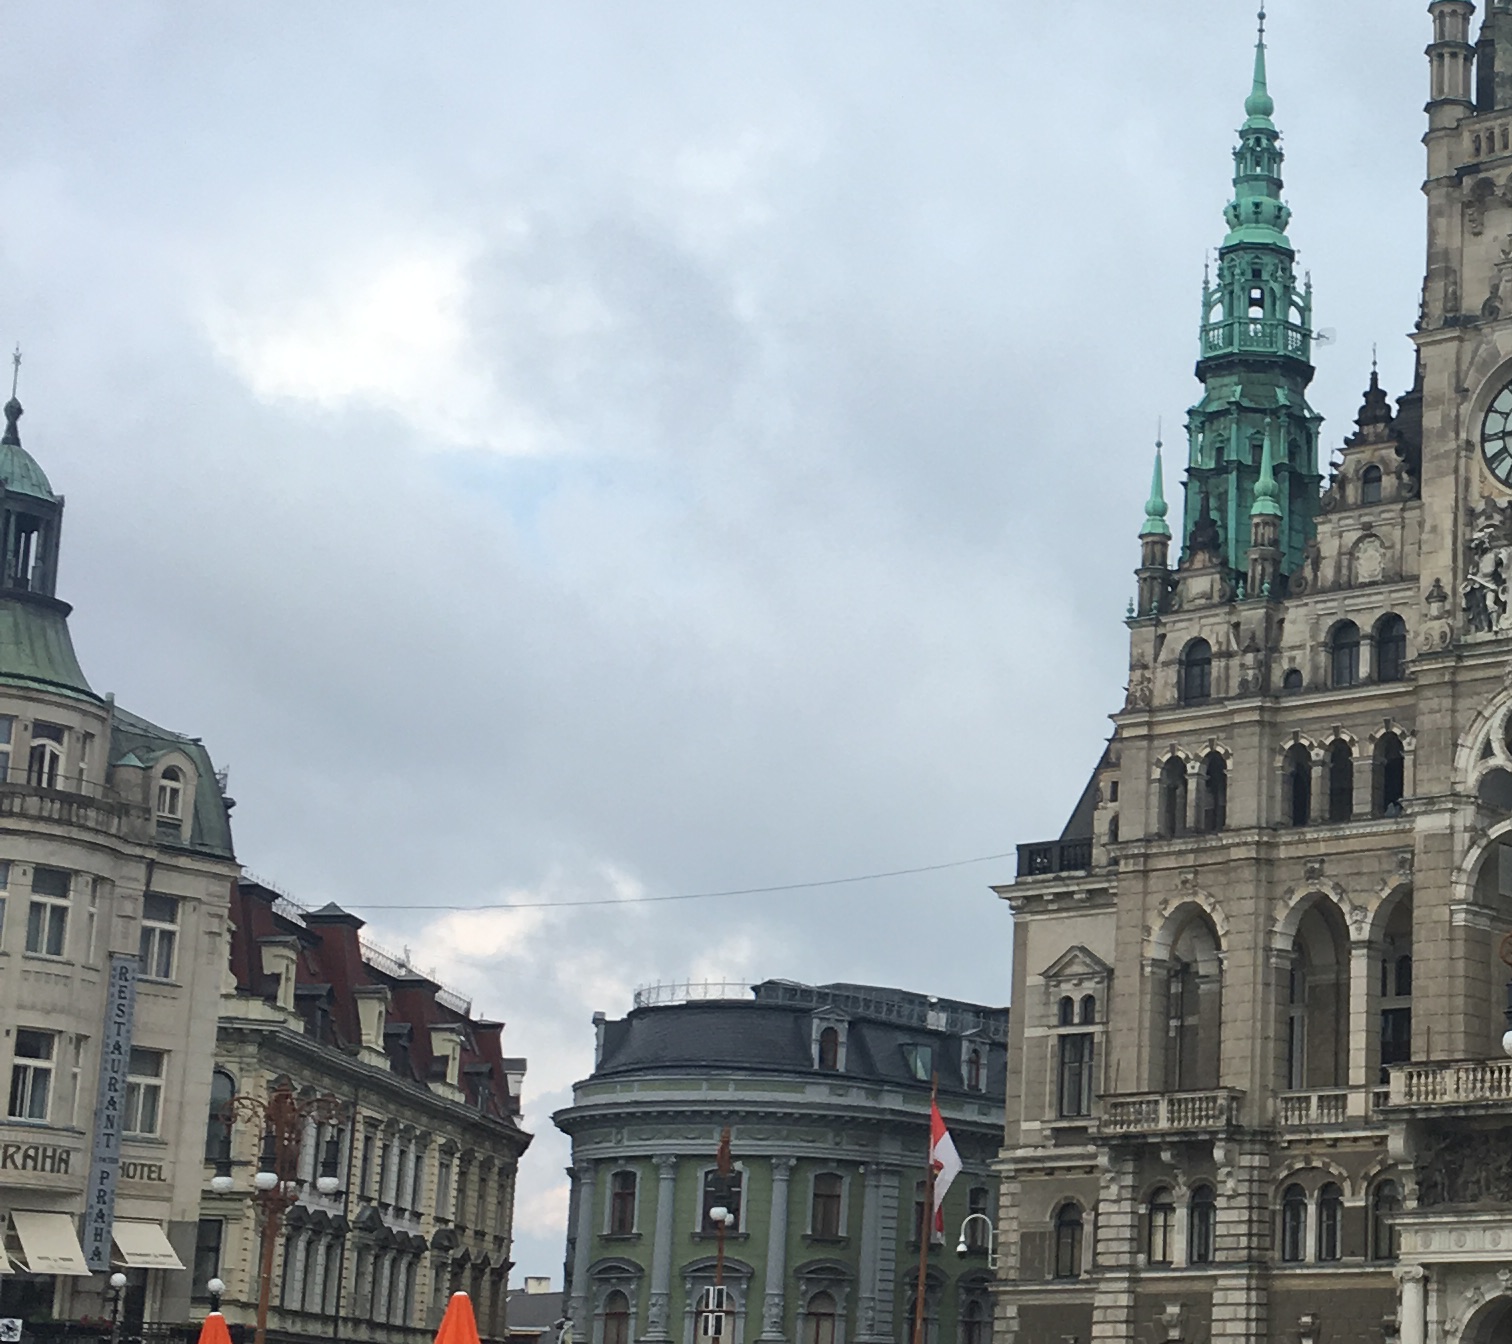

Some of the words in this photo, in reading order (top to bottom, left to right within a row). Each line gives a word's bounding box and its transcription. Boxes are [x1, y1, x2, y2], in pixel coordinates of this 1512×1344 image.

[102, 965, 130, 1149] RESTAURANT
[0, 1143, 71, 1175] RAHA
[89, 1170, 110, 1262] PRAHA
